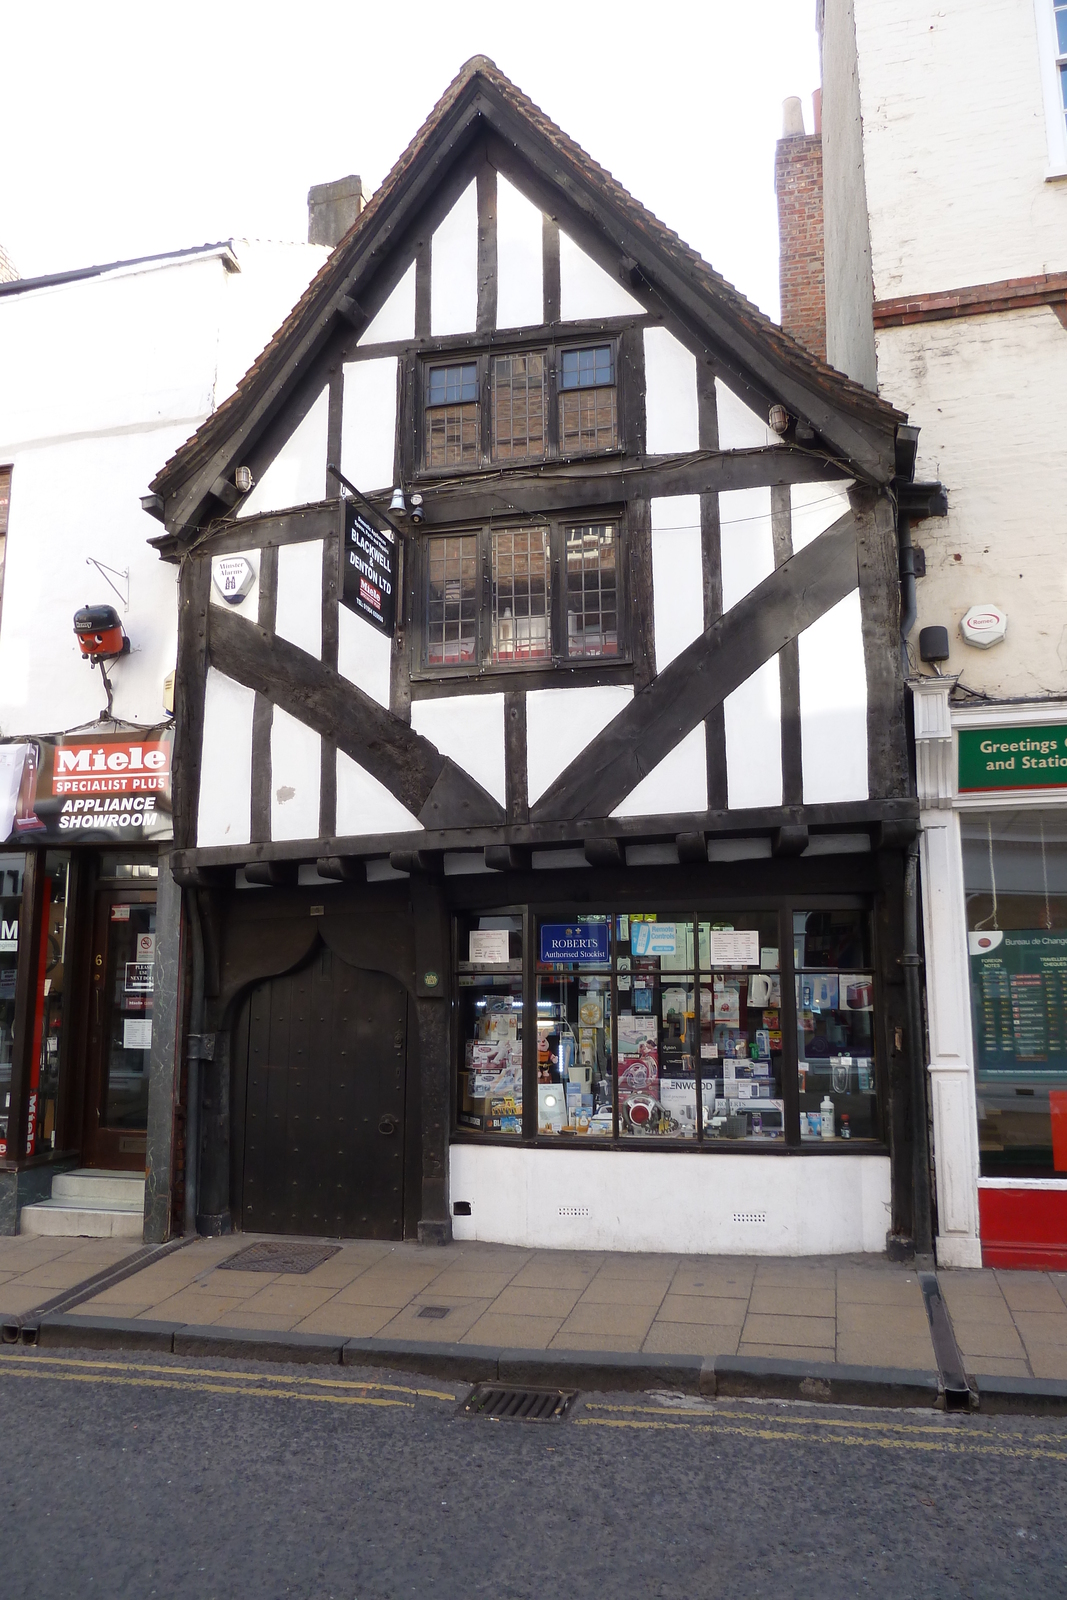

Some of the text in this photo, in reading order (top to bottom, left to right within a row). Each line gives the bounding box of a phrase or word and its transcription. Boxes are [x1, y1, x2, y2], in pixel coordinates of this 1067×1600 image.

[371, 527, 387, 546] Appliances
[351, 527, 391, 573] BLACKWELL
[219, 562, 244, 570] Minster
[369, 556, 374, 567] &
[350, 551, 391, 595] DENTON LTD
[360, 578, 381, 602] Miele
[980, 738, 1058, 754] Greetings
[57, 747, 166, 773] Miele
[986, 756, 1015, 771] and
[56, 778, 165, 793] SPECIALIST PLUS
[61, 796, 156, 813] APPLIANCE
[59, 813, 158, 829] SHOWROOM
[552, 939, 598, 948] ROBERTS
[1005, 938, 1031, 946] Bureau
[95, 954, 103, 966] 6
[579, 950, 605, 958] Stockist
[667, 1081, 713, 1090] ENWOOD
[26, 1093, 37, 1154] Miele
